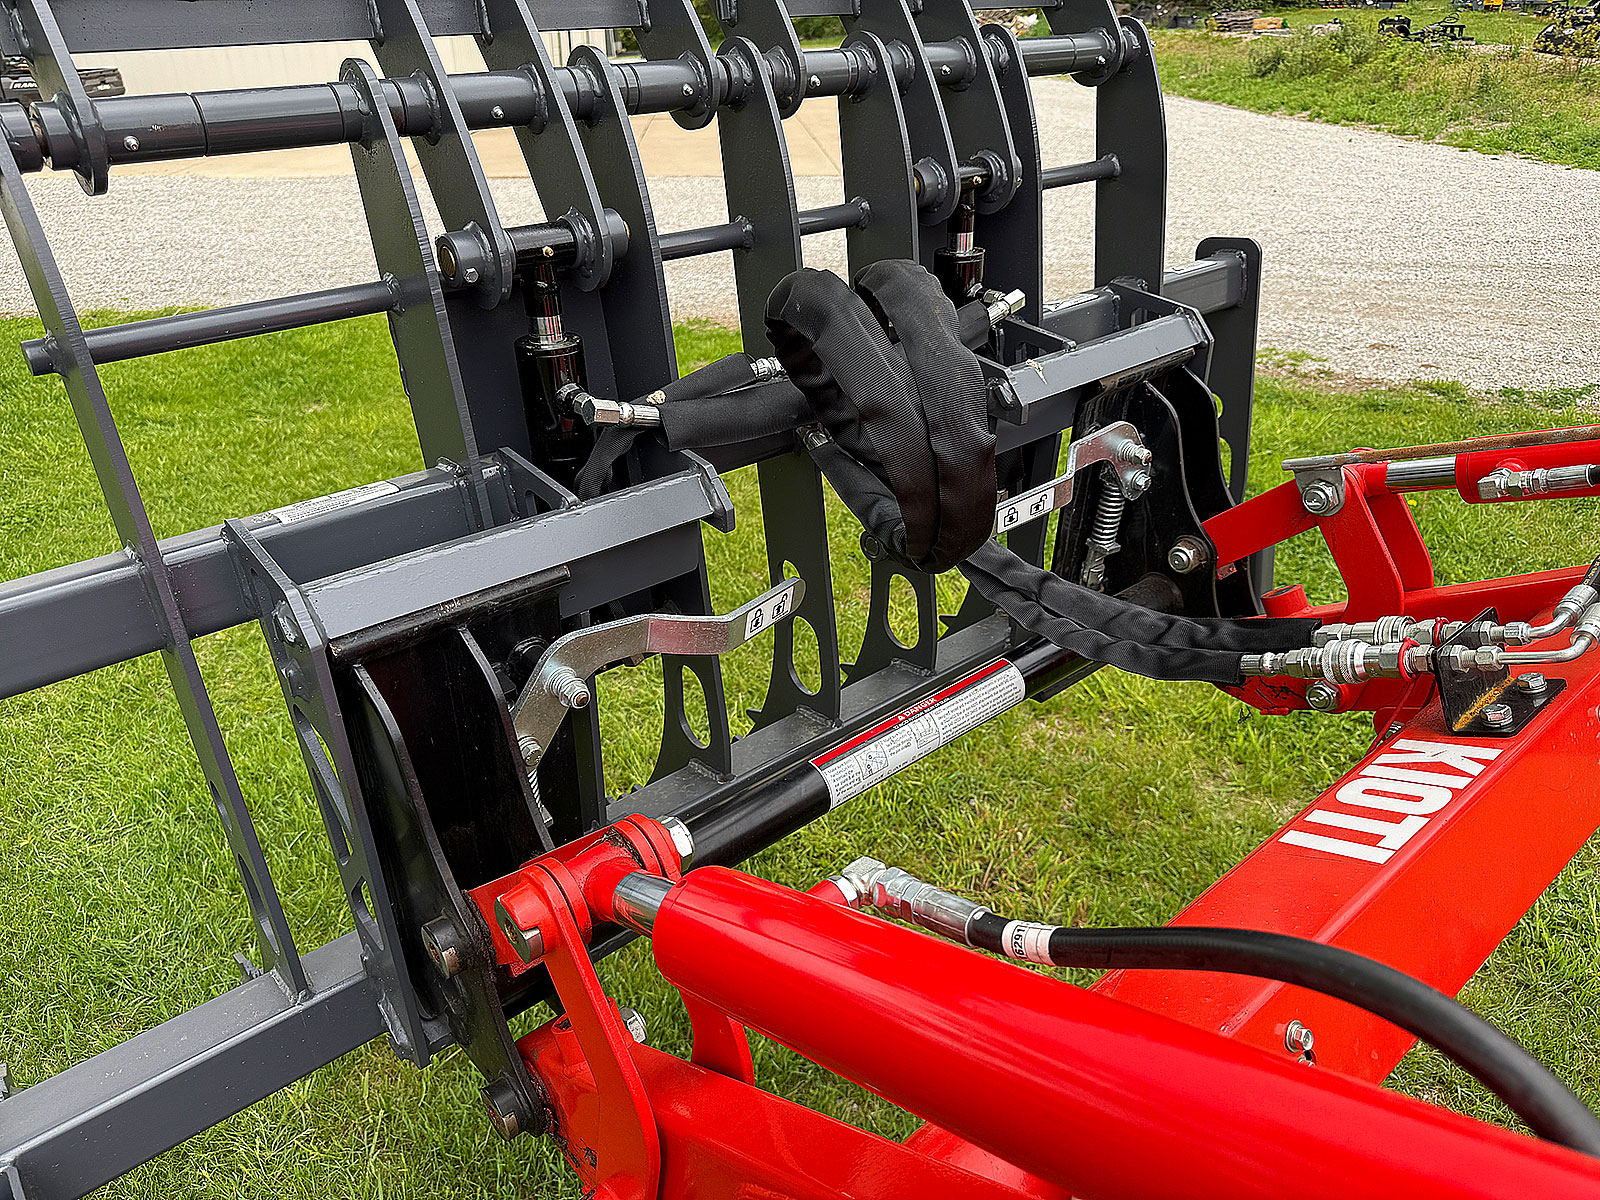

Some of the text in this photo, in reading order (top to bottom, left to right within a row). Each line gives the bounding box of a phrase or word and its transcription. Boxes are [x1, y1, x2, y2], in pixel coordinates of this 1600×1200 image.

[904, 697, 937, 718] DANGER
[1278, 738, 1504, 865] KIOTI
[1014, 928, 1026, 956] 6291
